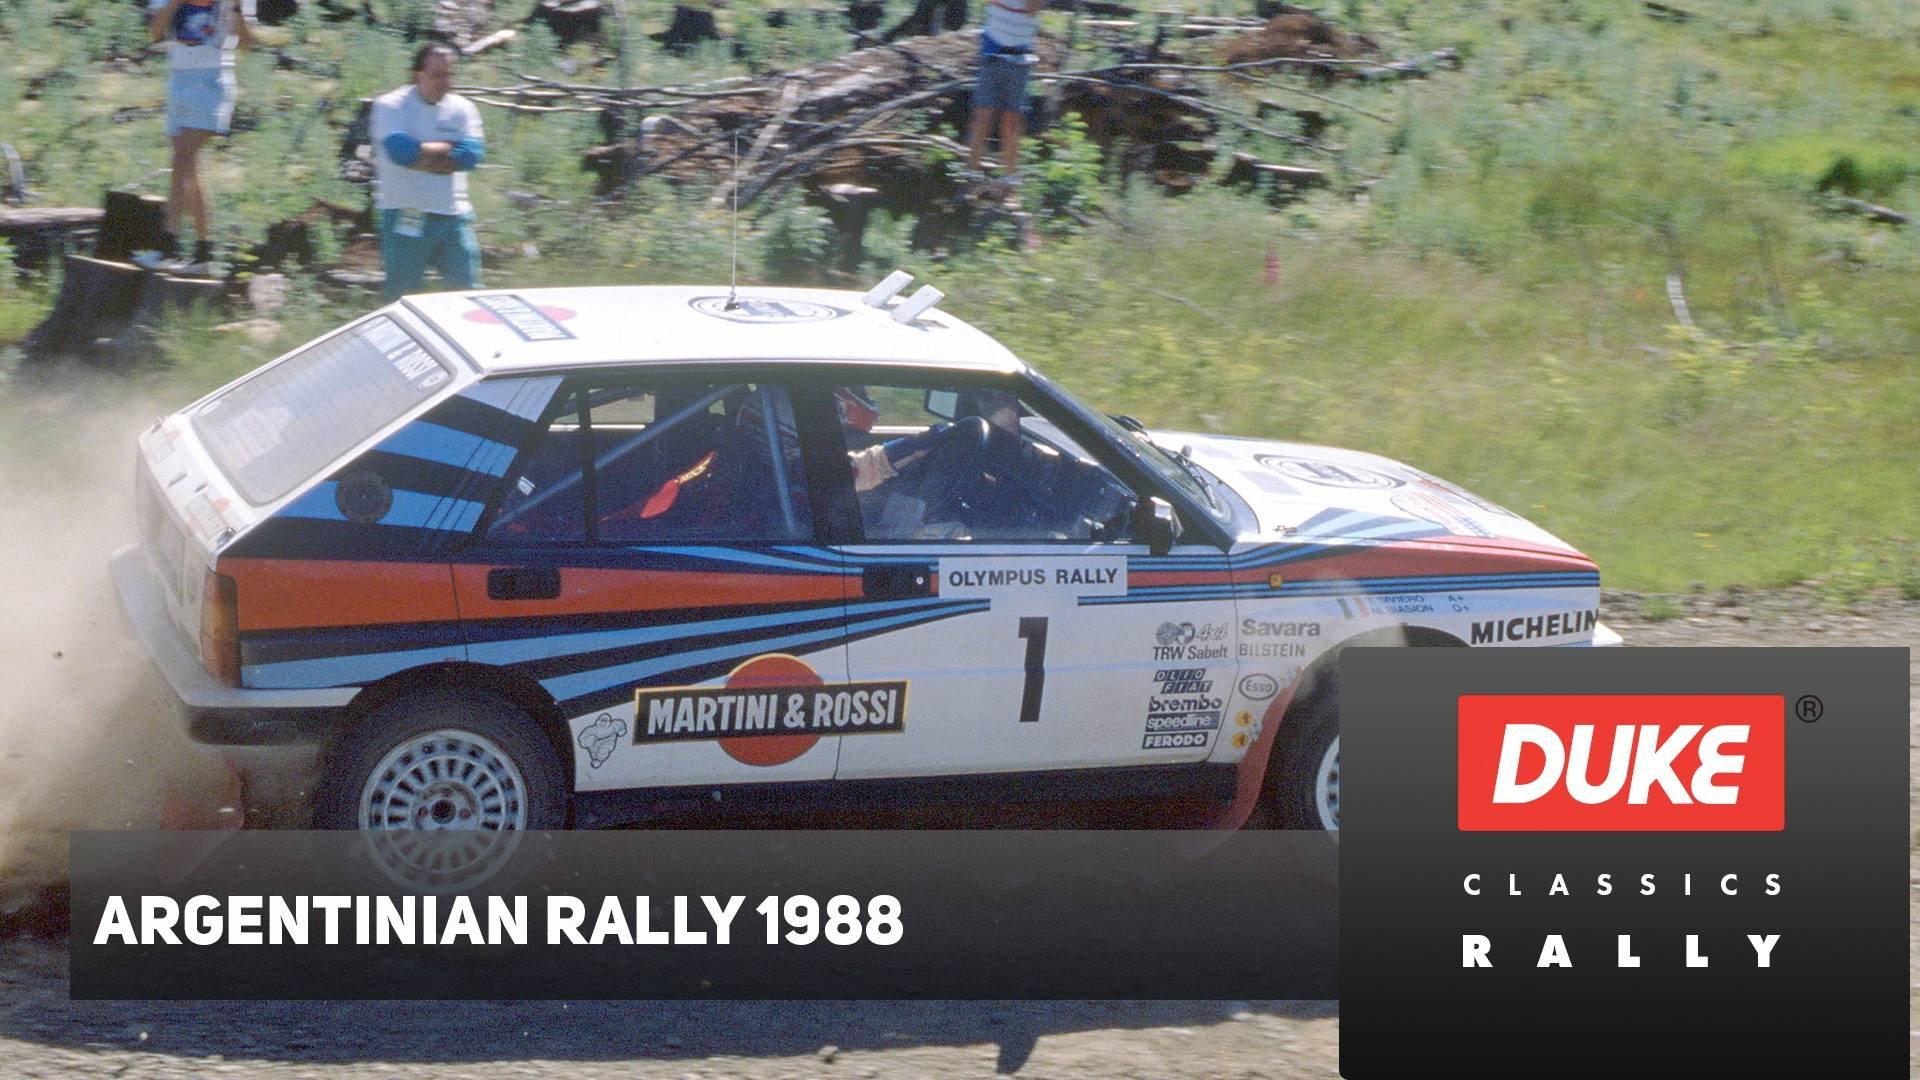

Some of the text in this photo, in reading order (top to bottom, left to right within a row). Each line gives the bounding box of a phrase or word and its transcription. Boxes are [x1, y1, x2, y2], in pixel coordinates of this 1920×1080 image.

[949, 567, 1118, 588] OLYMPUS RALLY
[1241, 618, 1321, 637] Savara
[1471, 608, 1600, 645] MICHELIN
[1153, 644, 1228, 660] TRW Sabelt
[1239, 643, 1305, 657] BILSTEIN
[1018, 616, 1049, 723] 1
[1156, 670, 1205, 681] OLIO
[1163, 682, 1212, 694] FIAT
[1245, 681, 1272, 693] Esso
[1150, 695, 1222, 712] brembo
[647, 690, 897, 735] MARTINI & ROSSI
[1147, 714, 1211, 731] speedline
[1145, 734, 1206, 748] FERODO
